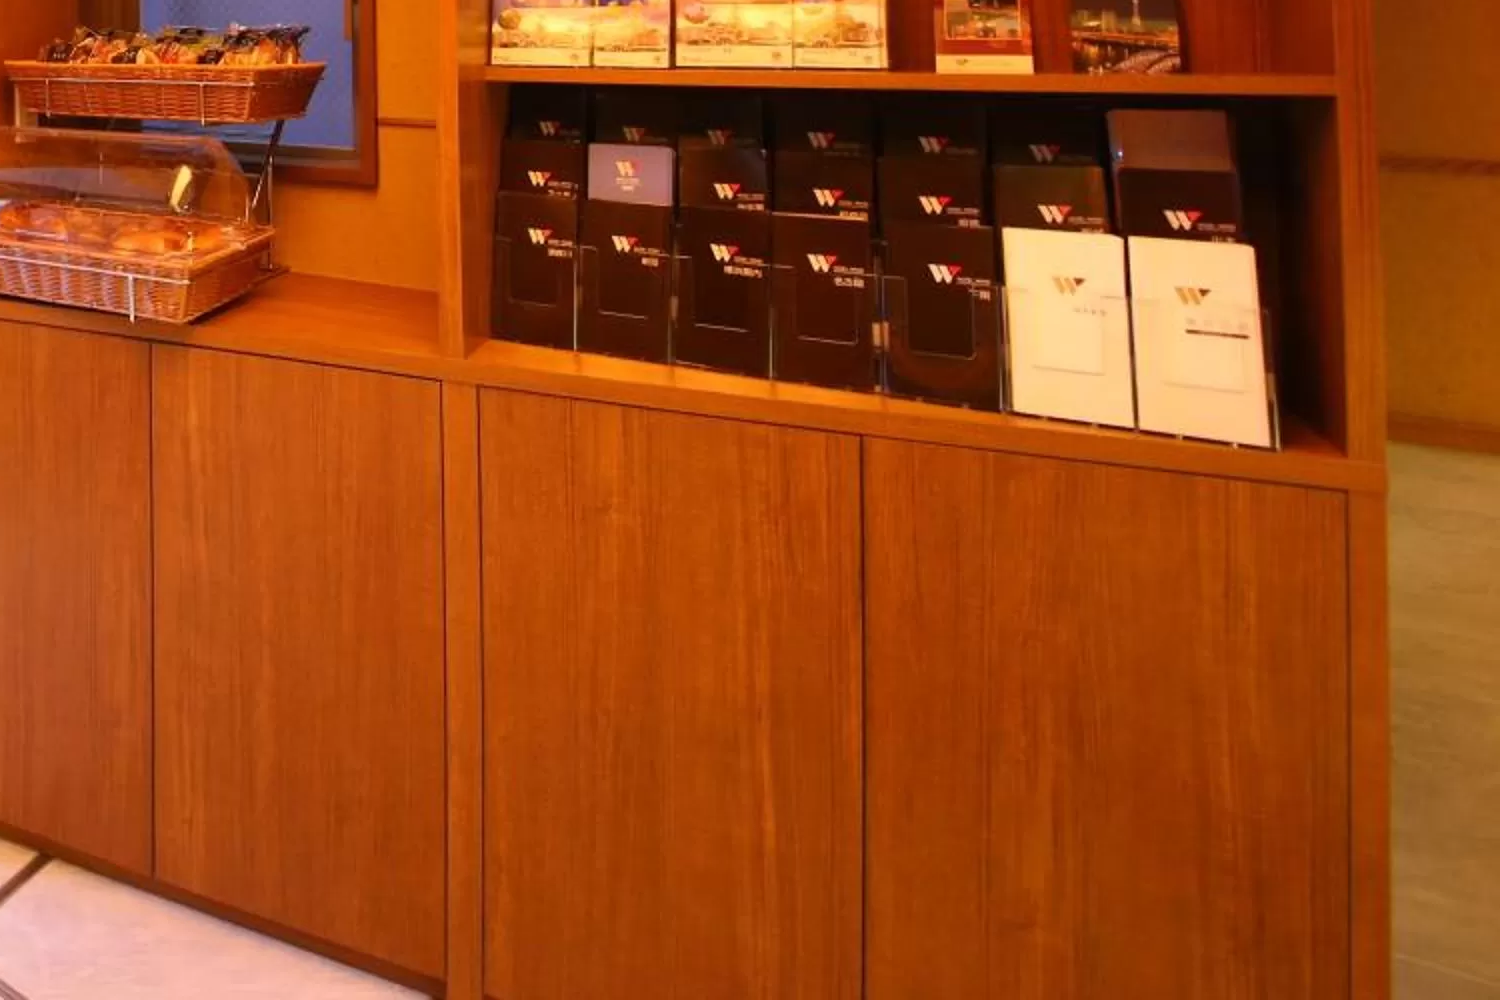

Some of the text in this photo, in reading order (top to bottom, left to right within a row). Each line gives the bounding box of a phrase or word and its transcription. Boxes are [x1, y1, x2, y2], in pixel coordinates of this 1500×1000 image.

[616, 160, 640, 176] W
[528, 171, 551, 188] W
[713, 183, 741, 200] W
[813, 189, 844, 208] W
[919, 196, 952, 215] W
[1037, 205, 1072, 225] W
[1163, 210, 1203, 231] W
[528, 228, 552, 246] W
[612, 235, 638, 254] W
[710, 242, 739, 264] W
[807, 253, 837, 274] W
[928, 264, 962, 285] W
[1051, 276, 1086, 296] W
[1174, 286, 1211, 306] W
